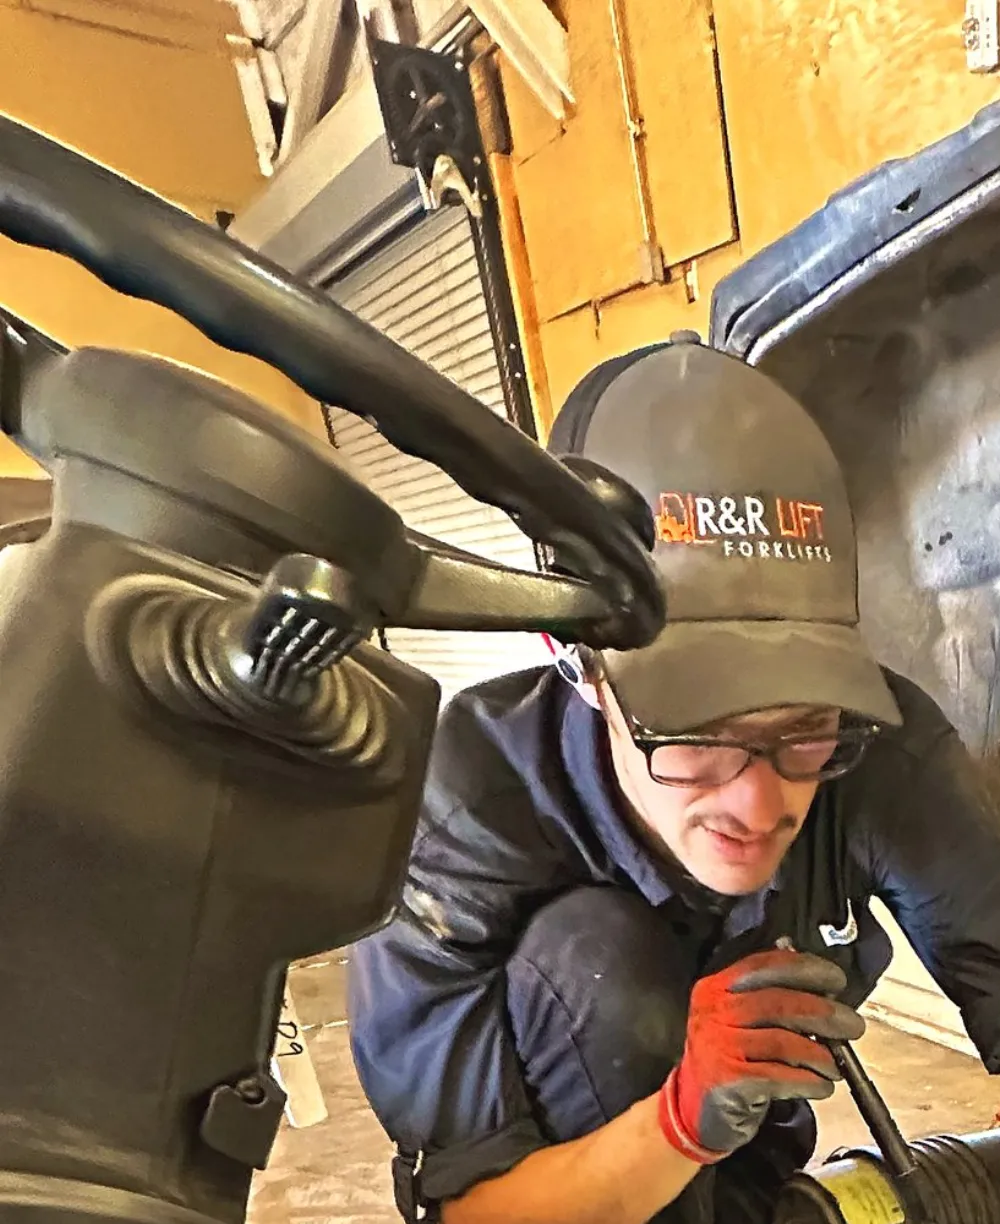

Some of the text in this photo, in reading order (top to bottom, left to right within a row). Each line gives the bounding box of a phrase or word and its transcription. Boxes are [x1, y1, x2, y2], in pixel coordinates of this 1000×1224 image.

[695, 496, 824, 540] R&R LIFT
[723, 540, 832, 563] FORKLIFTS
